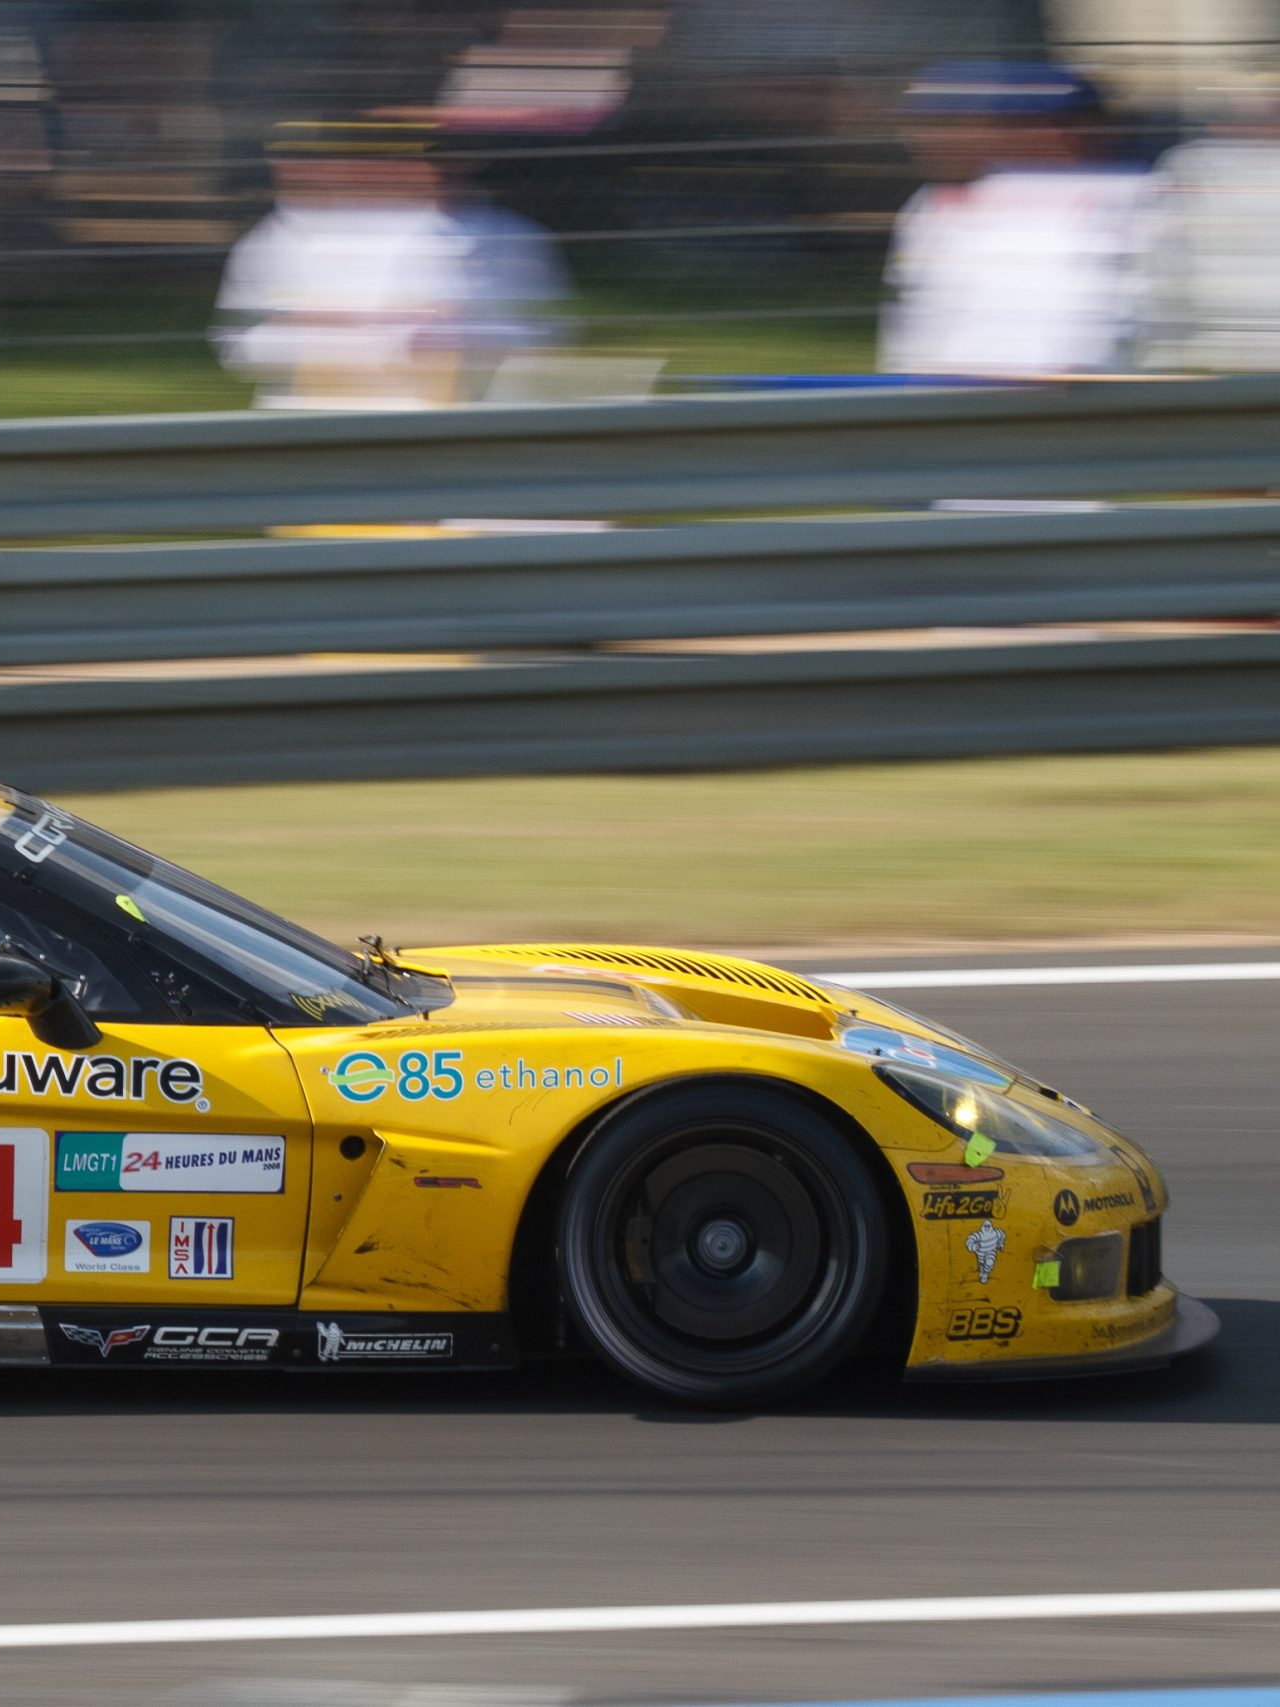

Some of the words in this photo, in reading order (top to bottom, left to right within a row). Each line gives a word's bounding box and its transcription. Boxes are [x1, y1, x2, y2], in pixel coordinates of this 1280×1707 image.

[475, 1057, 623, 1089] ethanol
[63, 1152, 118, 1172] LMGT1
[122, 1151, 162, 1173] 24
[164, 1152, 215, 1170] HEURES
[218, 1151, 237, 1166] DU
[241, 1147, 282, 1164] MANS
[262, 1162, 281, 1171] 2008
[174, 1221, 190, 1274] IMSA
[110, 1263, 140, 1271] Class
[946, 1307, 1022, 1342] BBS
[153, 1327, 280, 1346] GCA
[345, 1339, 448, 1351] MICHELIN
